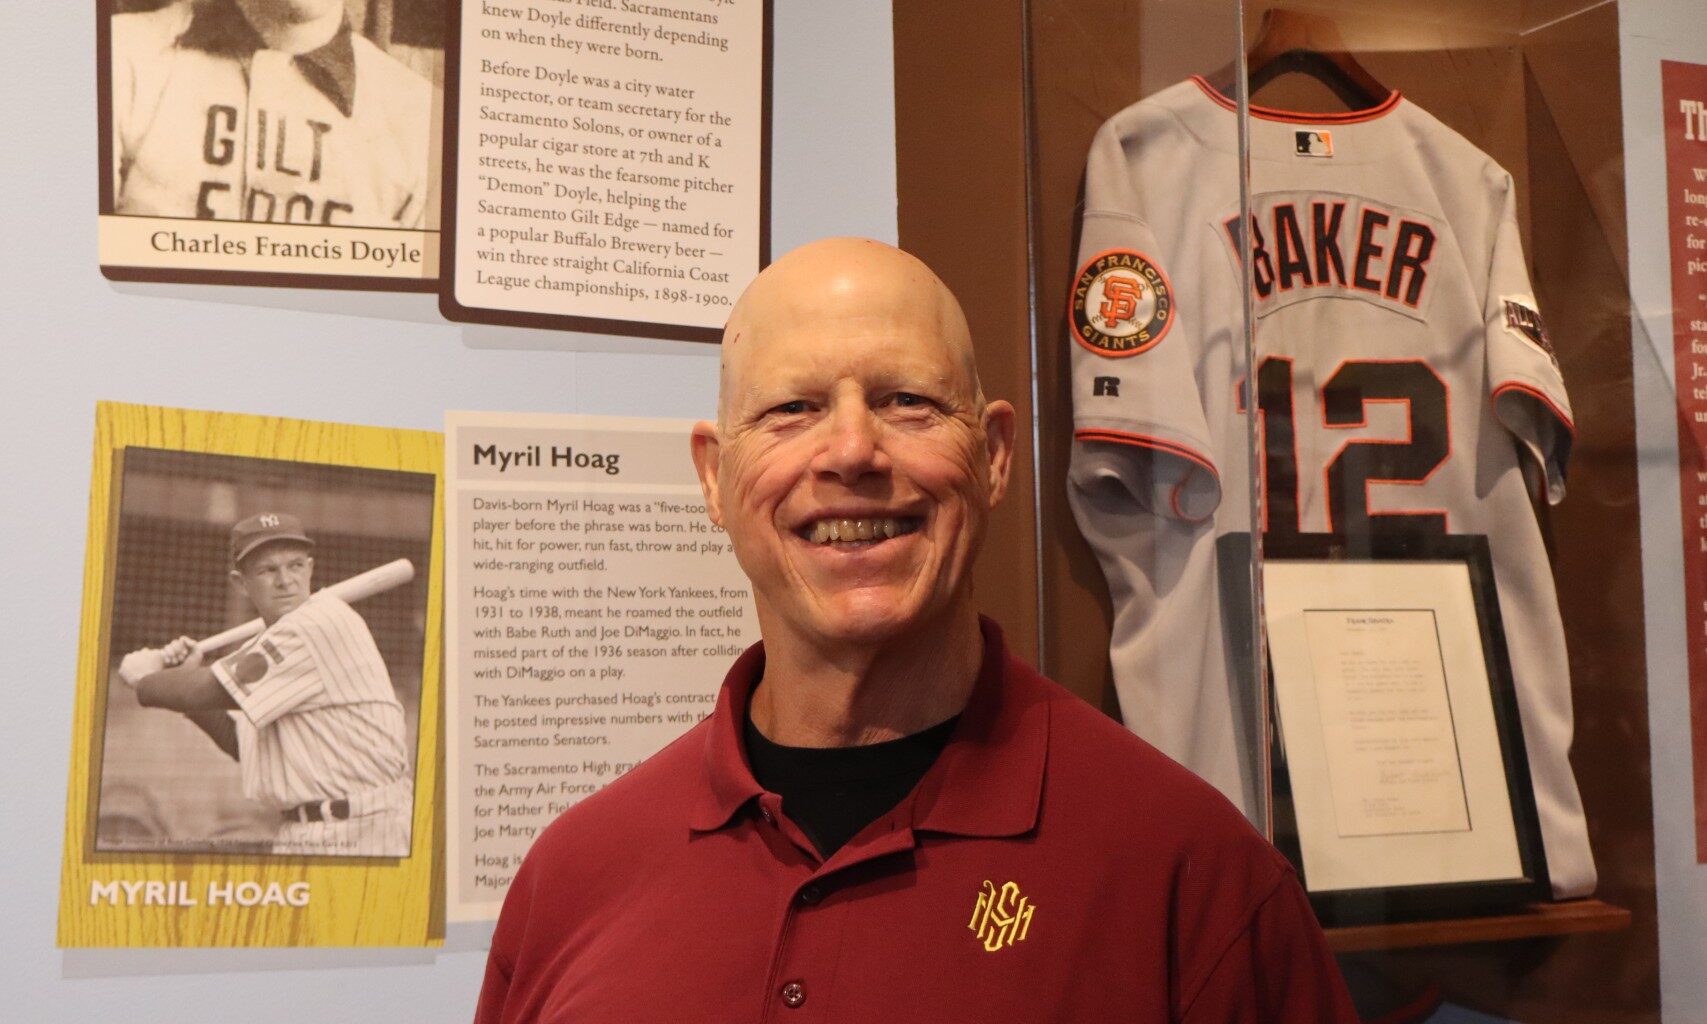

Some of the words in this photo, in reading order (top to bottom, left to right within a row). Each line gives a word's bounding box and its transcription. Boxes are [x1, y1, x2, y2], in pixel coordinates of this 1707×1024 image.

[621, 0, 718, 24] Sacramentans
[482, 1, 522, 18] knew
[528, 8, 571, 28] Doyle
[576, 14, 650, 40] differently
[654, 24, 728, 51] depending
[505, 28, 545, 45] when
[551, 33, 582, 54] they
[586, 42, 620, 55] were
[625, 43, 663, 61] born.
[481, 59, 530, 78] Before
[535, 66, 578, 86] Doyle
[582, 76, 609, 88] was
[625, 79, 651, 97] city
[655, 85, 695, 99] water
[480, 82, 552, 105] inspector,
[578, 97, 612, 111] team
[617, 104, 681, 123] secretary
[685, 107, 705, 122] for
[709, 110, 731, 126] the
[480, 106, 568, 128] Sacramento
[572, 117, 624, 137] Solons,
[648, 130, 692, 143] owner
[204, 104, 332, 182] GILT
[479, 133, 538, 149] popular
[542, 137, 578, 155] cigar
[582, 145, 617, 157] store
[640, 148, 662, 163] 7th
[667, 152, 693, 166] and
[478, 156, 530, 172] streets,
[558, 165, 584, 176] was
[589, 164, 611, 179] the
[616, 167, 679, 187] fearsome
[684, 176, 733, 193] pitcher
[478, 175, 549, 195] “Demon”
[554, 184, 601, 203] Doyle,
[607, 188, 660, 212] helping
[664, 195, 686, 210] the
[478, 199, 566, 220] Sacramento
[571, 209, 599, 224] Gilt
[604, 212, 639, 232] Edge
[662, 221, 709, 236] named
[713, 222, 733, 238] for
[151, 232, 246, 256] Charles
[255, 236, 341, 260] Francis
[350, 240, 420, 267] Doyle
[490, 227, 548, 243] popular
[553, 230, 606, 248] Buffalo
[611, 236, 671, 258] Brewery
[675, 241, 705, 257] beer
[1222, 202, 1436, 308] BAKER
[476, 248, 504, 261] win
[510, 249, 548, 265] three
[553, 256, 608, 274] straight
[613, 259, 684, 278] California
[689, 267, 729, 283] Coast
[476, 270, 530, 290] League
[534, 275, 648, 301] championships,
[654, 287, 732, 306] 1898-1900.
[1076, 272, 1092, 310] SAN
[1096, 255, 1168, 320] FRANCISCO
[1082, 324, 1150, 348] GIANTS
[1237, 356, 1452, 535] 12
[473, 444, 541, 472] Myril
[551, 446, 620, 475] Hoag
[472, 497, 542, 510] Davis-born
[546, 498, 578, 514] Myril
[583, 499, 614, 515] Hoag
[617, 504, 641, 512] was
[473, 518, 510, 532] player
[515, 518, 555, 530] before
[560, 519, 579, 530] the
[584, 520, 624, 534] phrase
[628, 523, 651, 532] was
[655, 521, 686, 532] born.
[473, 538, 492, 550] hit,
[496, 538, 512, 550] hit
[516, 538, 534, 550] for
[539, 542, 581, 553] power,
[585, 542, 604, 550] run
[609, 539, 632, 552] fast,
[636, 540, 672, 551] throw
[676, 540, 696, 552] and
[701, 541, 723, 555] play
[473, 558, 553, 573] wide-ranging
[558, 558, 607, 570] outfield.
[473, 586, 514, 601] Hoag's
[519, 587, 547, 598] time
[552, 586, 578, 598] with
[583, 586, 602, 598] the
[607, 586, 636, 598] New
[638, 586, 665, 598] York
[668, 586, 717, 598] Yankees,
[720, 586, 747, 598] from
[475, 606, 502, 618] 1931
[530, 606, 561, 619] 1938,
[565, 609, 602, 618] meant
[626, 606, 671, 617] roamed
[675, 606, 694, 617] the
[698, 605, 742, 617] outfield
[473, 626, 501, 638] with
[506, 626, 536, 638] Babe
[541, 626, 570, 637] Ruth
[575, 626, 596, 637] and
[600, 626, 619, 640] Joe
[624, 625, 682, 640] DiMaggio.
[700, 625, 724, 637] fact,
[473, 646, 516, 658] missed
[521, 649, 547, 661] part
[568, 646, 588, 657] the
[595, 645, 622, 657] 1936
[627, 648, 666, 657] season
[671, 644, 698, 656] after
[473, 666, 501, 678] with
[506, 666, 565, 681] DiMaggio
[600, 665, 624, 680] play.
[474, 694, 499, 706] The
[502, 694, 550, 707] Yankees
[555, 693, 617, 708] purchased
[622, 691, 661, 707] Hoag's
[494, 714, 536, 730] posted
[542, 714, 606, 728] impressive
[610, 712, 662, 724] numbers
[667, 712, 692, 722] with
[474, 735, 549, 748] Sacramento
[553, 733, 610, 745] Senators.
[474, 763, 499, 776] The
[504, 763, 578, 775] Sacramento
[583, 760, 610, 775] High
[474, 785, 495, 797] the
[498, 784, 533, 798] Army
[536, 782, 555, 794] Air
[474, 804, 493, 817] for
[498, 804, 541, 815] Mather
[473, 825, 494, 842] Joe
[499, 824, 535, 837] Marty
[475, 853, 508, 867] Hoag
[90, 880, 197, 906] MYRIL
[208, 881, 310, 907] HOAG
